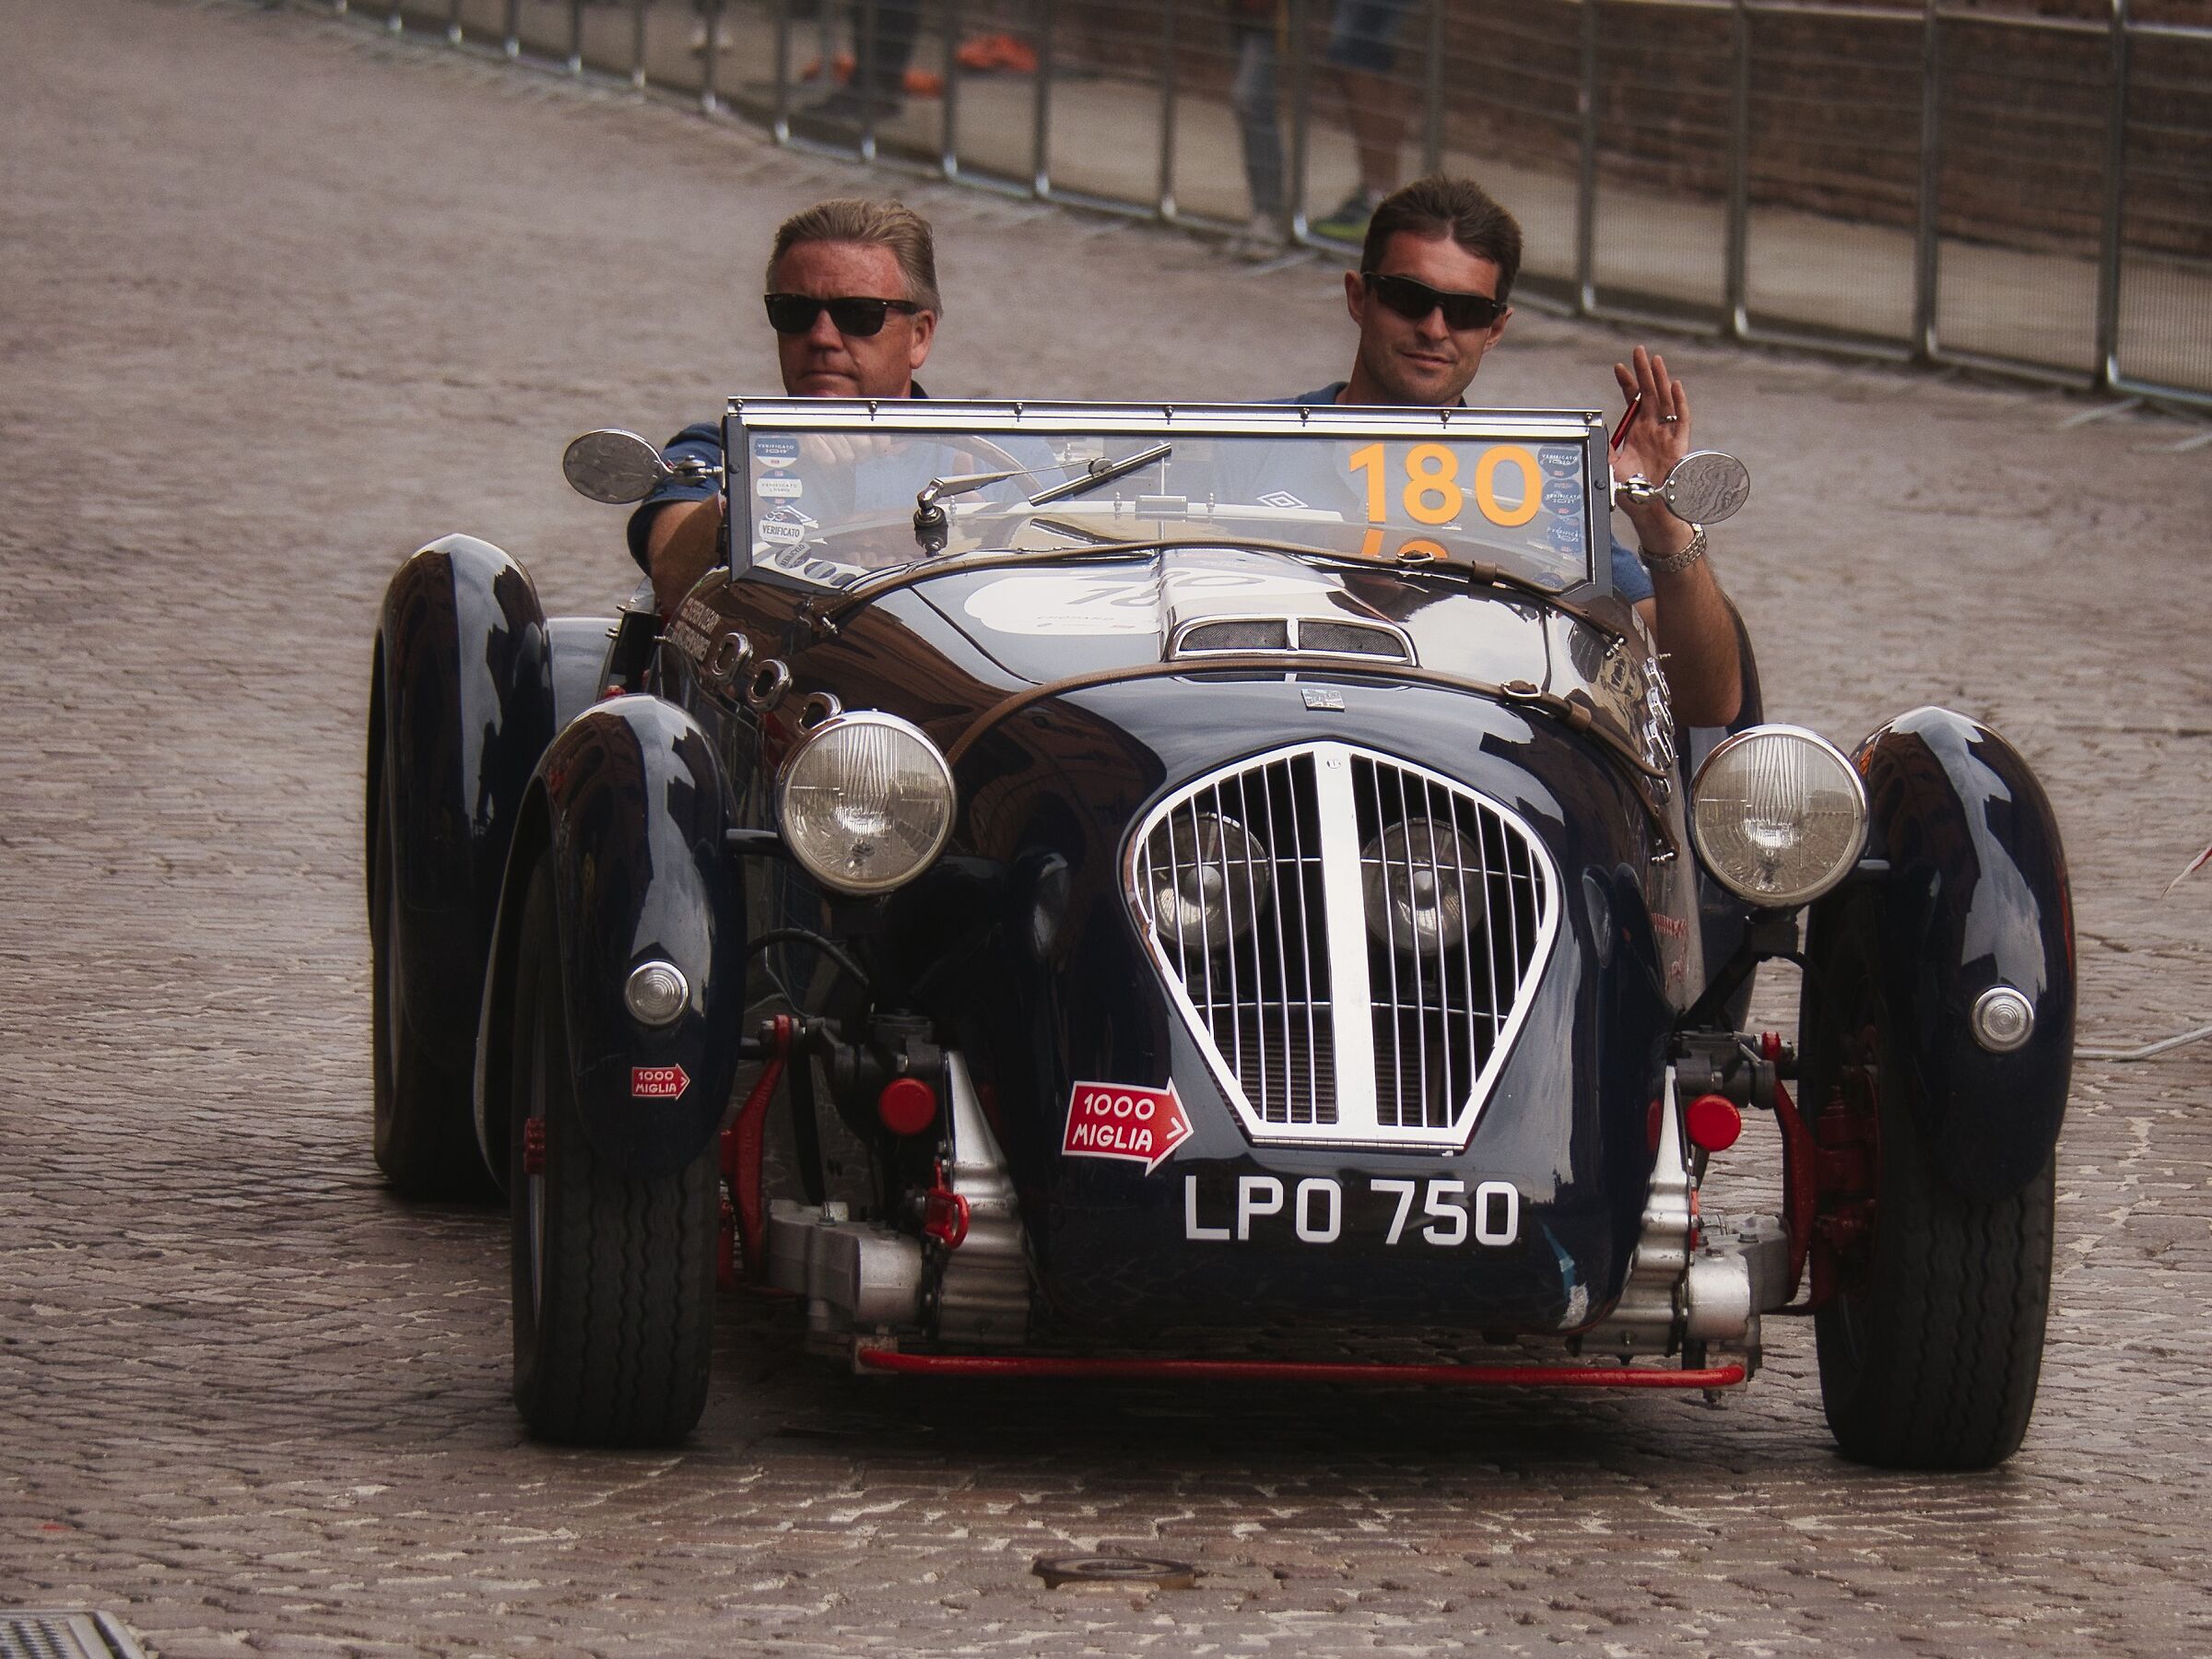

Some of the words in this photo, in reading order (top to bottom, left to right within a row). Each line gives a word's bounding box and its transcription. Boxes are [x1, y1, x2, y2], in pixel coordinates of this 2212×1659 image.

[1349, 442, 1543, 526] 180
[762, 524, 800, 538] VERIFICATO
[635, 1083, 677, 1093] MIGLIA
[638, 1071, 674, 1080] 1000
[1083, 1093, 1156, 1120] 1000
[1072, 1123, 1154, 1152] MIGLIA
[1185, 1175, 1342, 1243] LPO
[1371, 1179, 1519, 1246] 750
